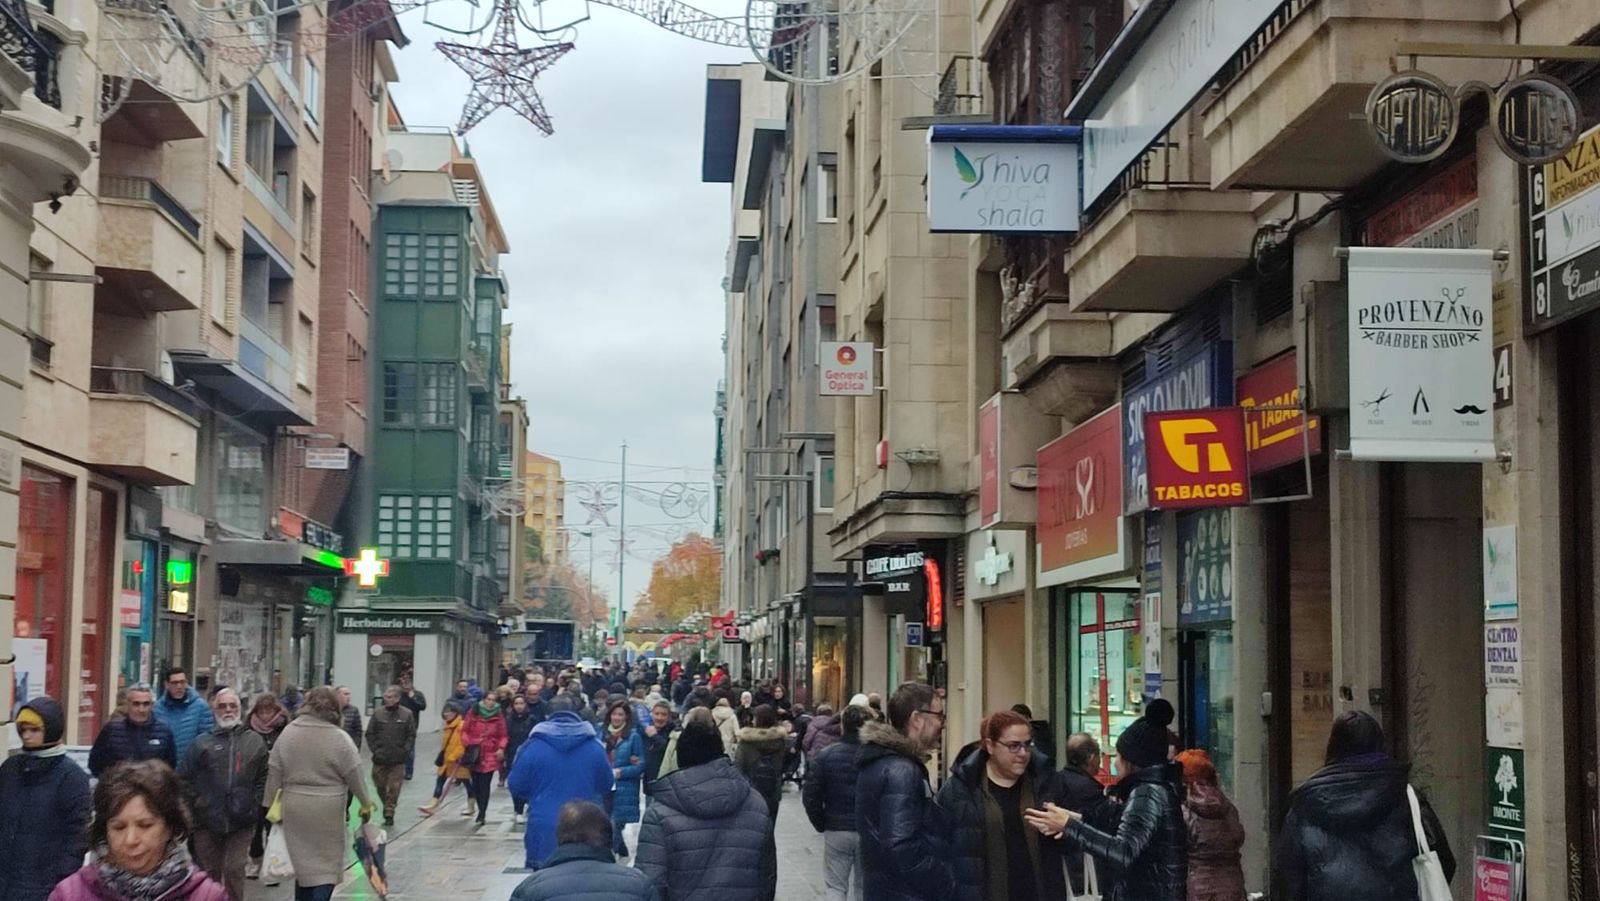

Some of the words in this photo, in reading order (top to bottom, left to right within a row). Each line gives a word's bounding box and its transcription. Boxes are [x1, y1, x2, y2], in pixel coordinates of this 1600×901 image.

[1534, 172, 1544, 206] 6
[976, 201, 1045, 228] shala
[1534, 228, 1545, 261] 7
[1536, 281, 1546, 315] 8
[1358, 299, 1483, 327] PROVENZANO
[1376, 330, 1428, 350] BARBER
[1433, 331, 1467, 349] SHOP
[825, 370, 869, 380] General
[828, 380, 865, 392] Optica
[1155, 482, 1244, 501] TABACOS
[887, 582, 911, 593] BAR
[343, 617, 403, 629] Herbolario
[1487, 628, 1518, 644] CENTRO
[1487, 647, 1518, 663] DENTAL
